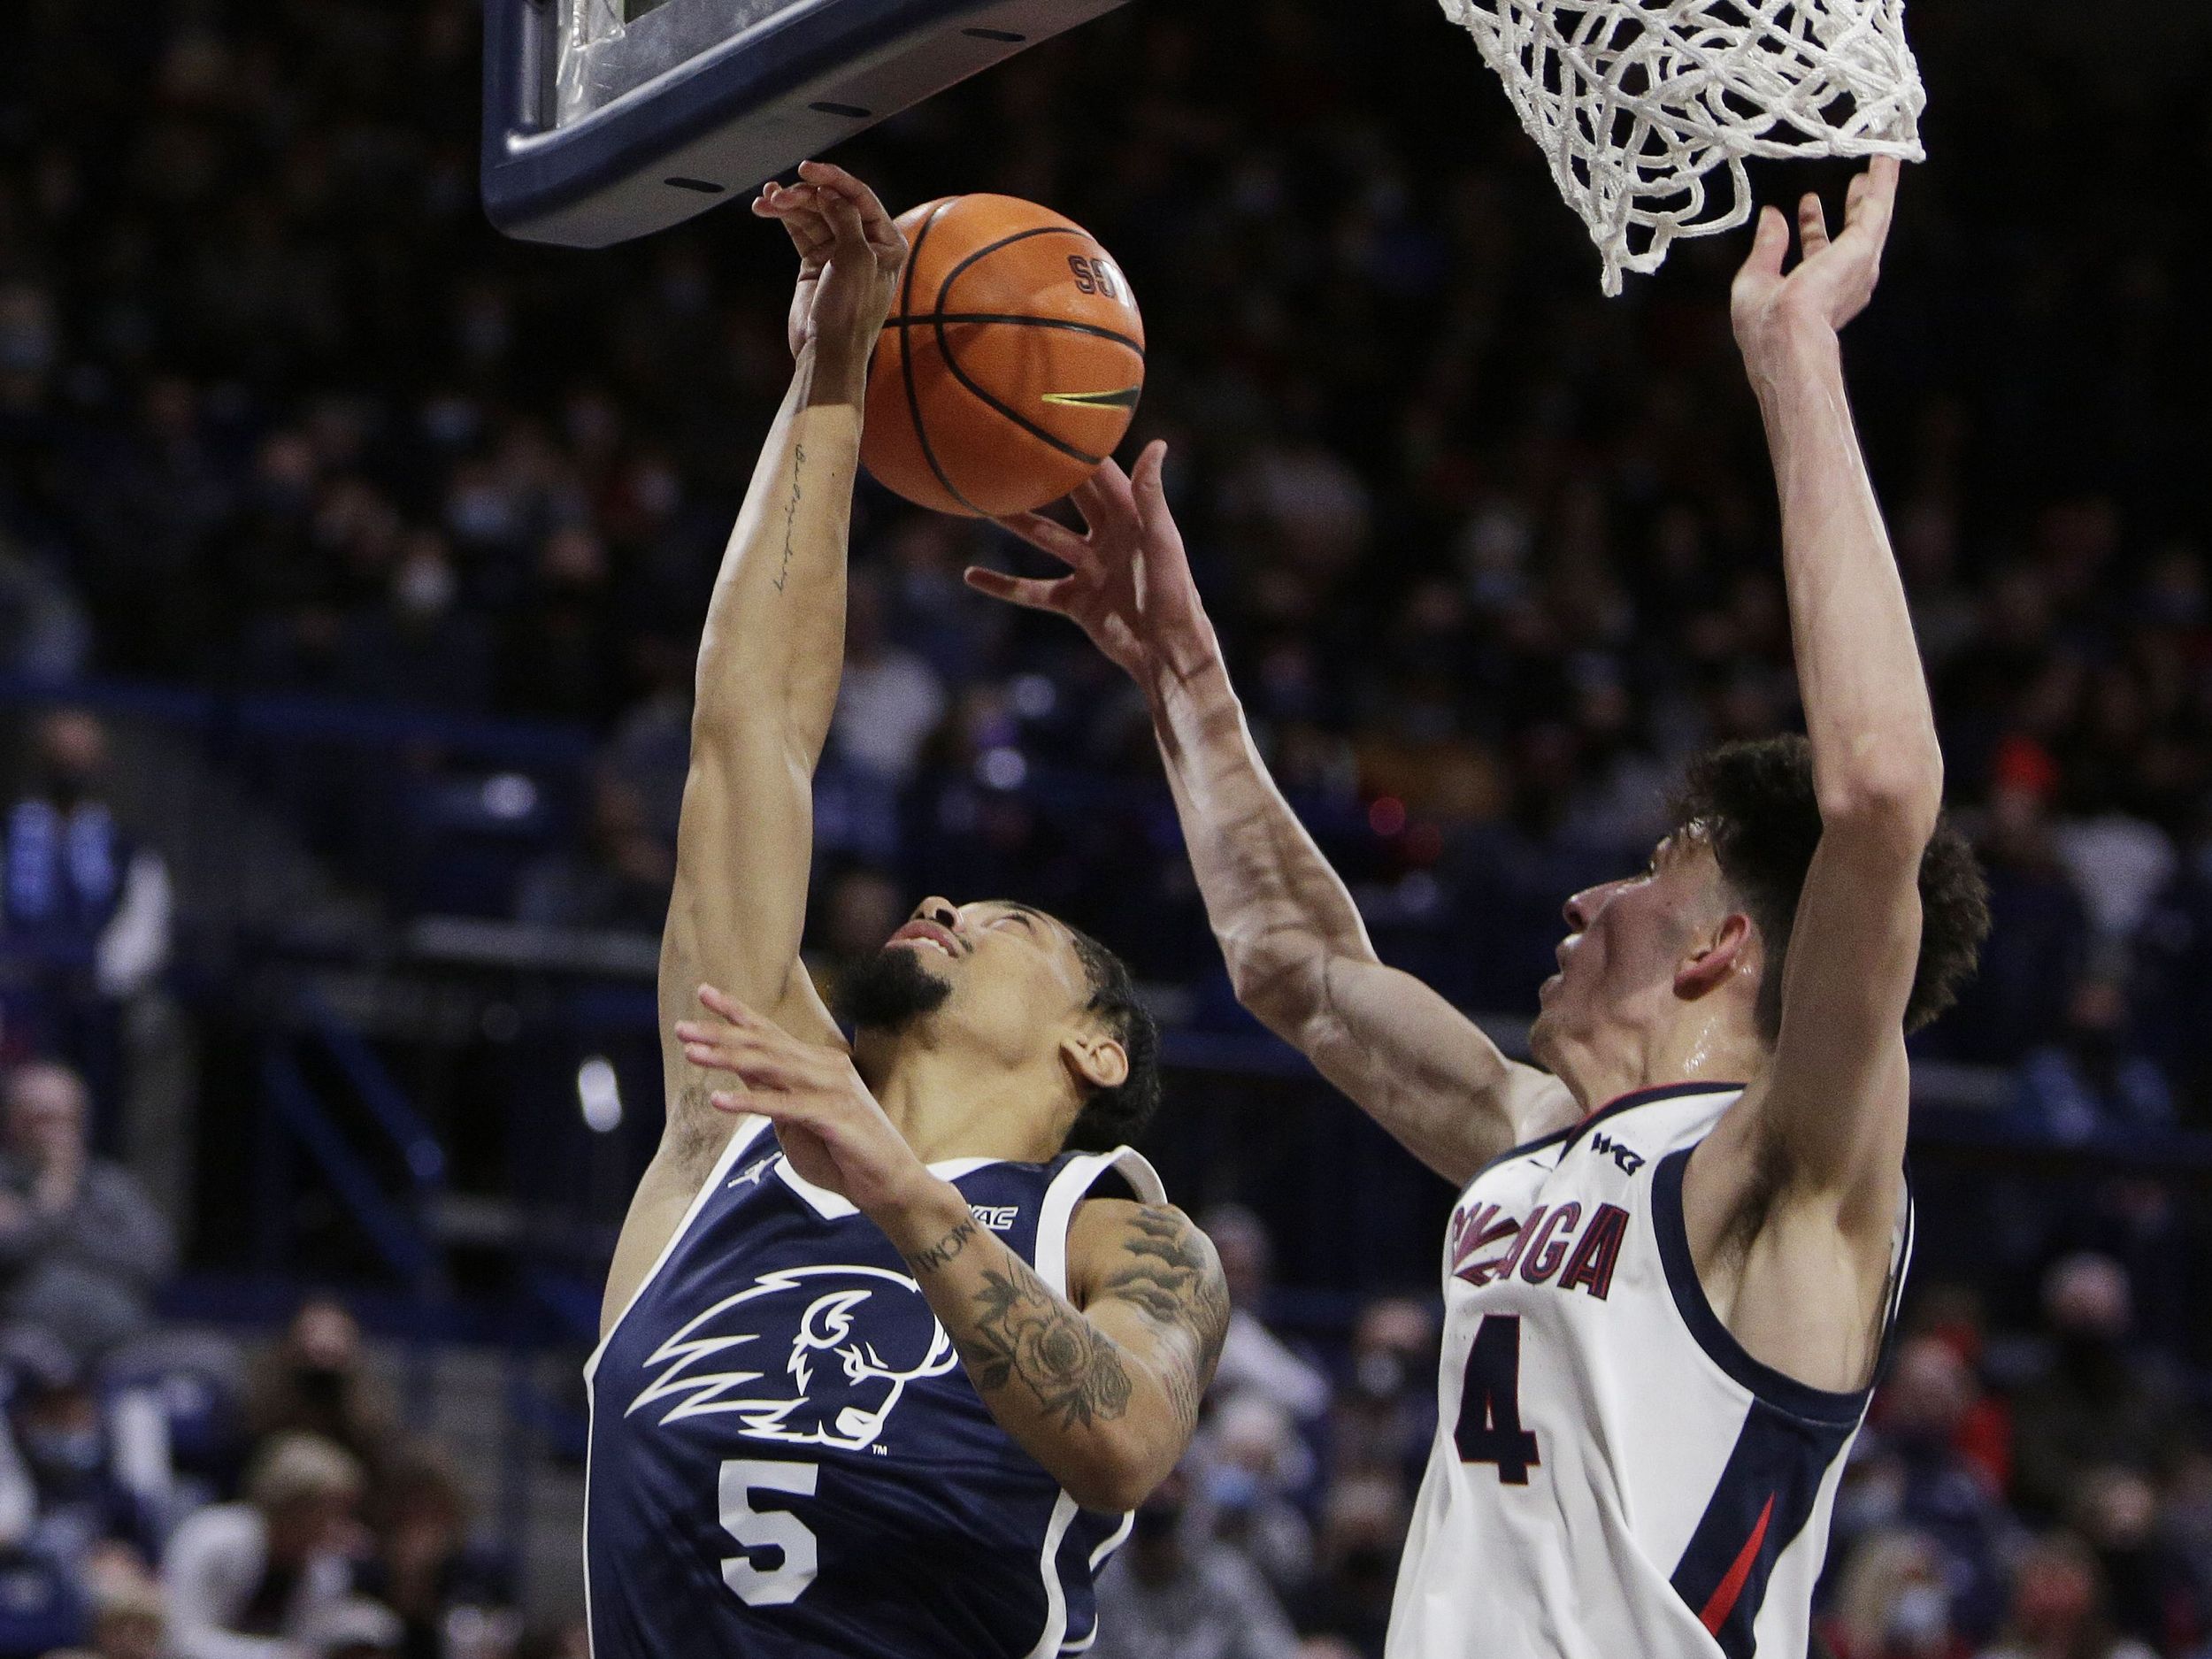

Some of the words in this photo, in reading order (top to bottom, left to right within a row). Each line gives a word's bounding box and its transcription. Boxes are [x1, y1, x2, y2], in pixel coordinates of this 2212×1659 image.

[872, 1443, 888, 1456] TM
[1454, 1313, 1541, 1486] 4
[718, 1458, 819, 1608] 5
